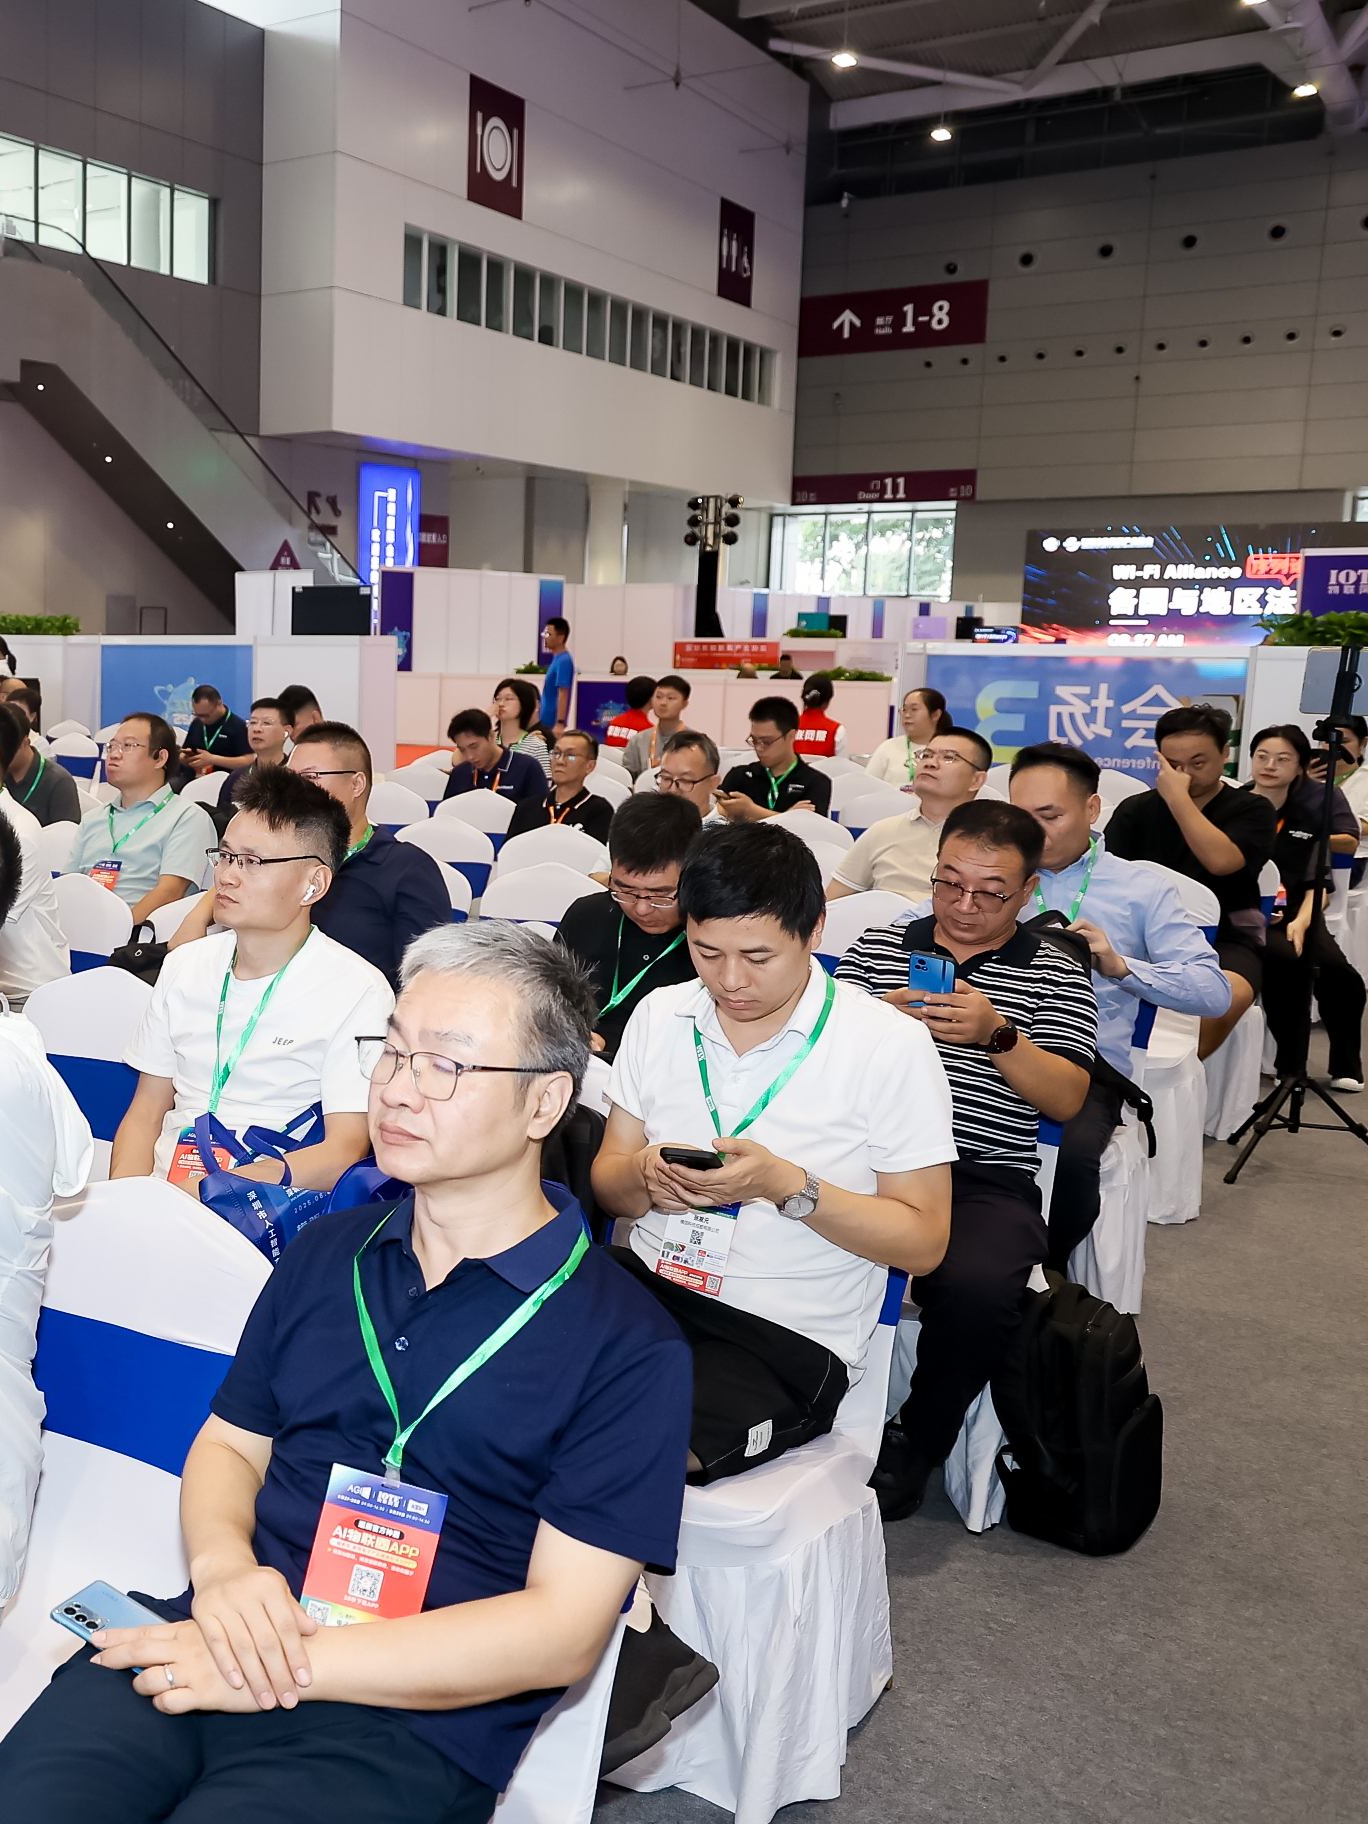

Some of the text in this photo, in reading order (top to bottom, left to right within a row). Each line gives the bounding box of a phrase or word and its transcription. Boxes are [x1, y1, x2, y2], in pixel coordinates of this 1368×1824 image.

[901, 300, 950, 334] 1-8
[857, 477, 907, 500] Door 11
[1111, 564, 1162, 581] Wi-Fi
[1163, 563, 1243, 580] Alliance
